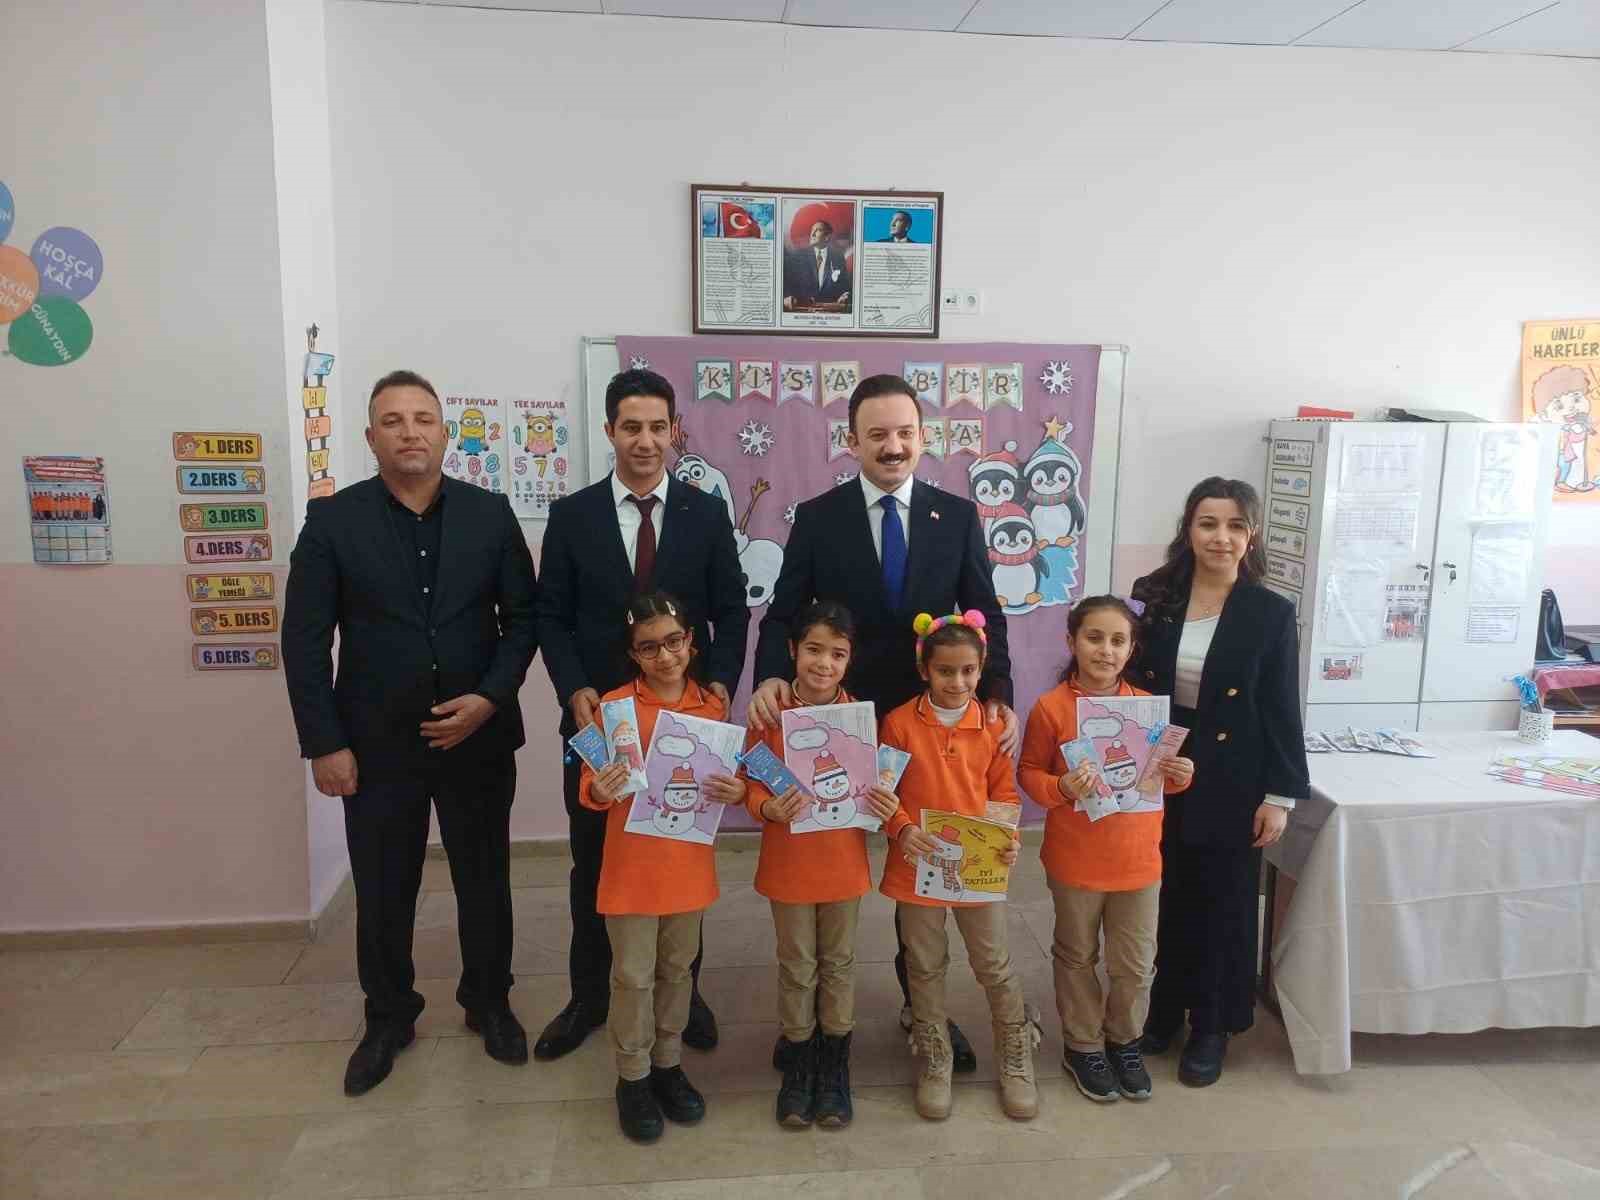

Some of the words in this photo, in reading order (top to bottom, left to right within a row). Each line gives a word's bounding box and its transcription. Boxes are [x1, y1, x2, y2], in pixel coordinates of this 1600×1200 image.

[44, 263, 73, 290] KAL
[1533, 342, 1600, 358] HARFLER
[488, 422, 501, 440] 2
[513, 425, 522, 445] 1
[204, 439, 215, 454] 1.
[217, 438, 254, 454] DERS
[445, 452, 461, 473] 4
[485, 453, 500, 473] 8
[514, 456, 527, 475] 5
[534, 460, 548, 478] 7
[189, 472, 238, 487] 2.DERS
[208, 508, 257, 524] 3.DERS
[196, 541, 244, 556] 4.DERS
[219, 613, 233, 627] 5.
[235, 612, 271, 626] DERS
[203, 650, 251, 665] 6.DERS
